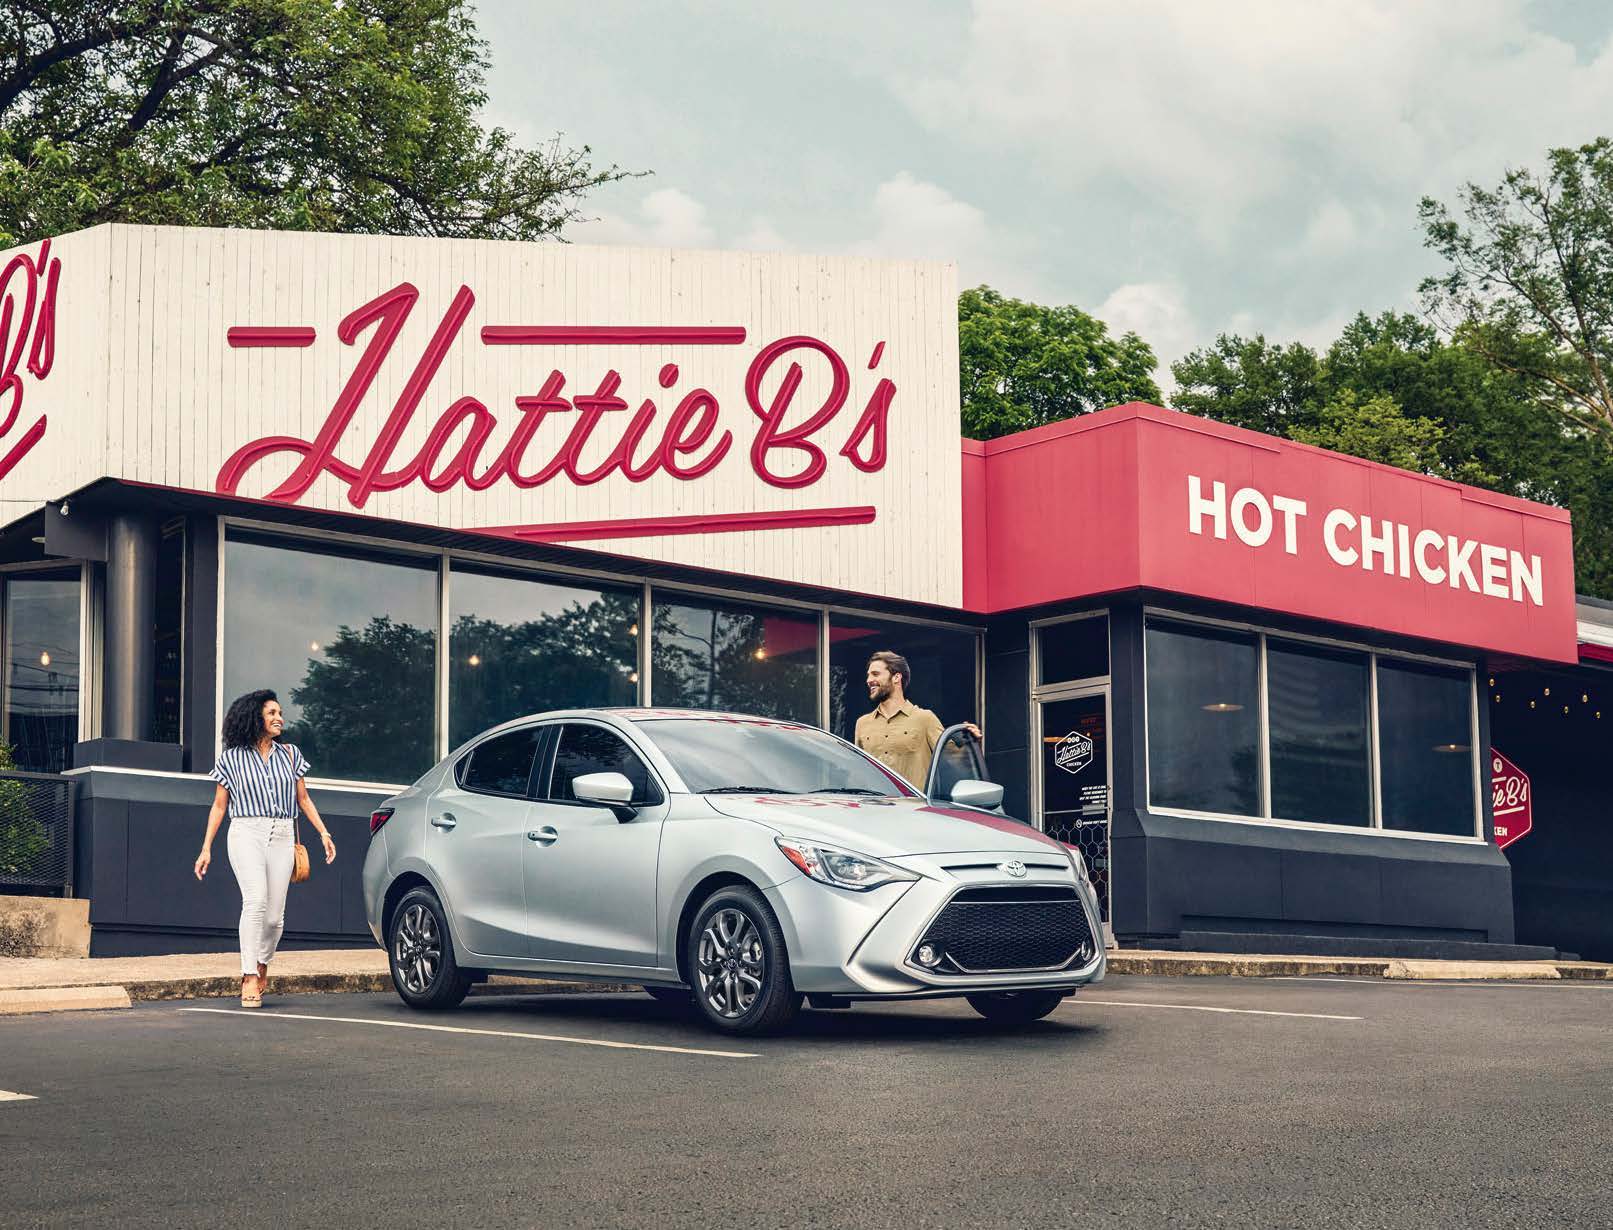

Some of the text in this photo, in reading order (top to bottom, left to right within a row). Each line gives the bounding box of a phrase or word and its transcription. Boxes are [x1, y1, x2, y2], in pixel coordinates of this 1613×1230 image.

[214, 282, 897, 509] Hattie B's
[1187, 474, 1544, 607] HOT CHICKEN
[1506, 776, 1528, 807] B's
